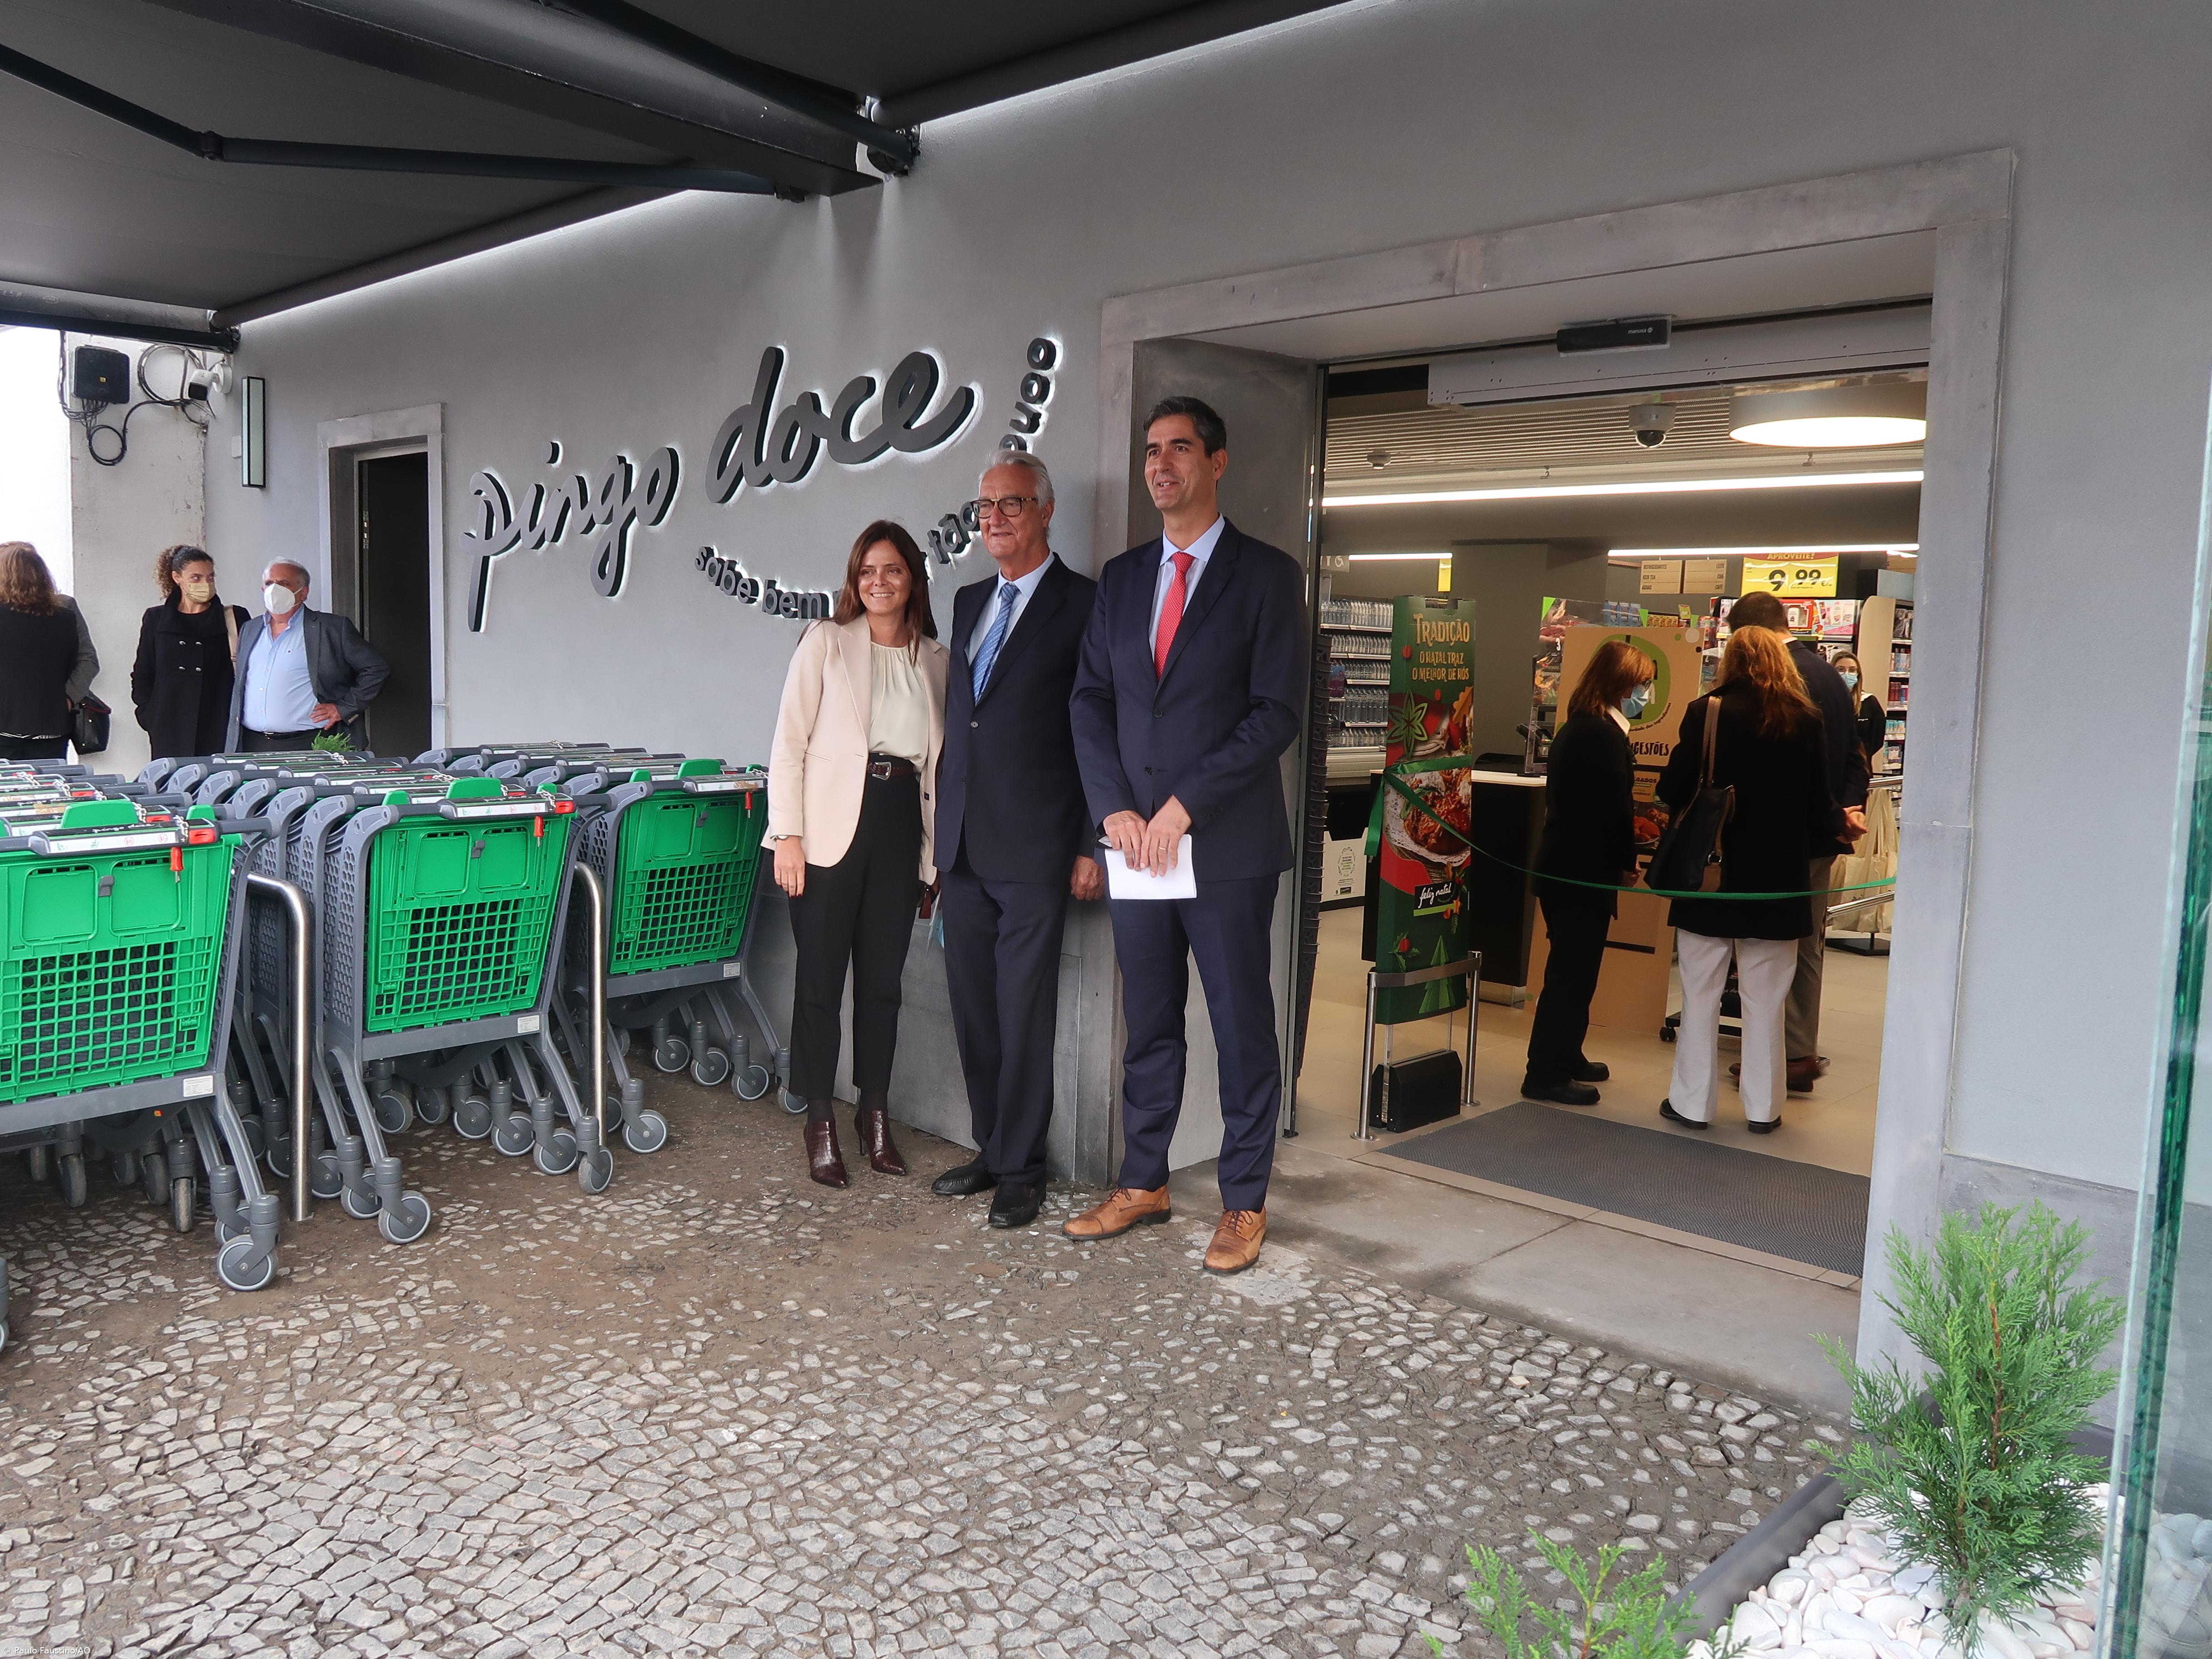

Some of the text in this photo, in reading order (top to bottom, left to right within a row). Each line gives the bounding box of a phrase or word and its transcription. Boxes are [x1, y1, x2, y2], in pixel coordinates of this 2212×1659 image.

[460, 346, 975, 632] pingo doce
[694, 337, 1056, 618] sabe bem tão ouco
[1769, 569, 1786, 591] 9
[1413, 613, 1470, 647] TRADIÇÃO
[1555, 638, 1561, 651] 3
[1419, 651, 1464, 666] O NATAL TRAZ
[1412, 666, 1469, 682] O MELHOR DE NÓS
[1418, 882, 1452, 909] feliz natal
